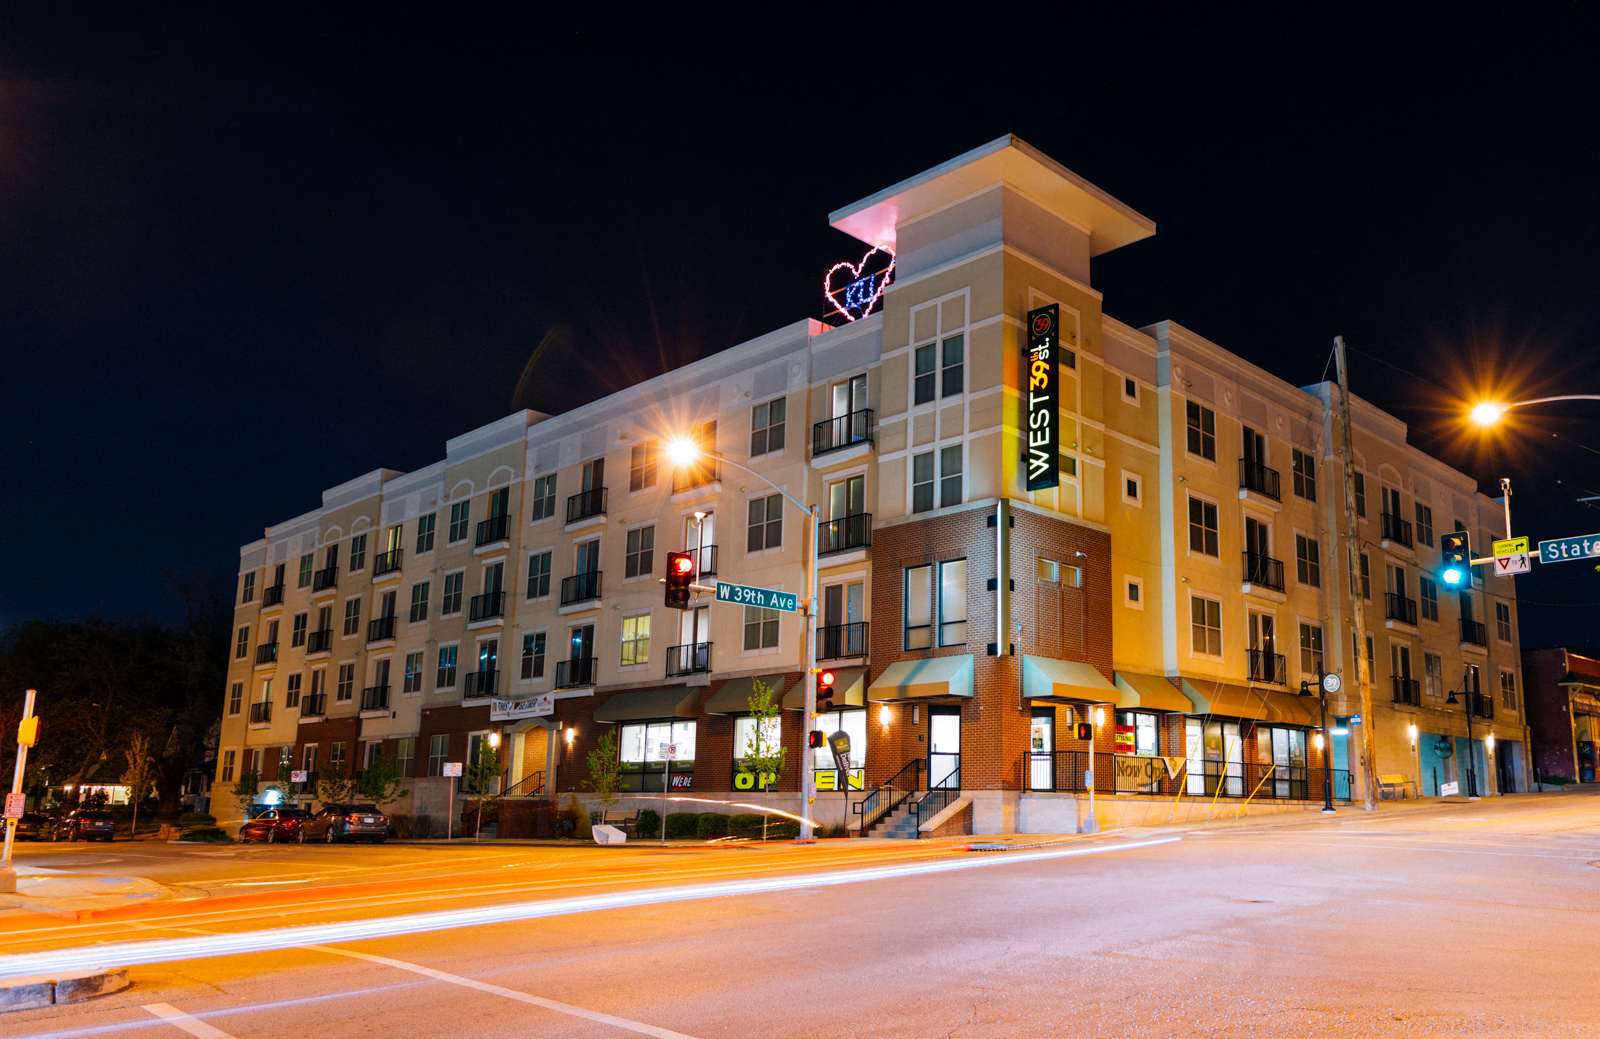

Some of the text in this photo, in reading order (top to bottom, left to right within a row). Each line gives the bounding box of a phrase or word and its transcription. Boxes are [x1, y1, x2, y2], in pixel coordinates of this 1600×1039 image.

[845, 273, 876, 309] KU
[1035, 317, 1050, 331] 39
[1029, 391, 1050, 480] WEST
[1548, 539, 1600, 559] State
[720, 584, 794, 609] W 39th Ave
[1326, 678, 1338, 687] 39
[1116, 724, 1134, 732] ELIVERY
[1116, 760, 1168, 782] Now Ope
